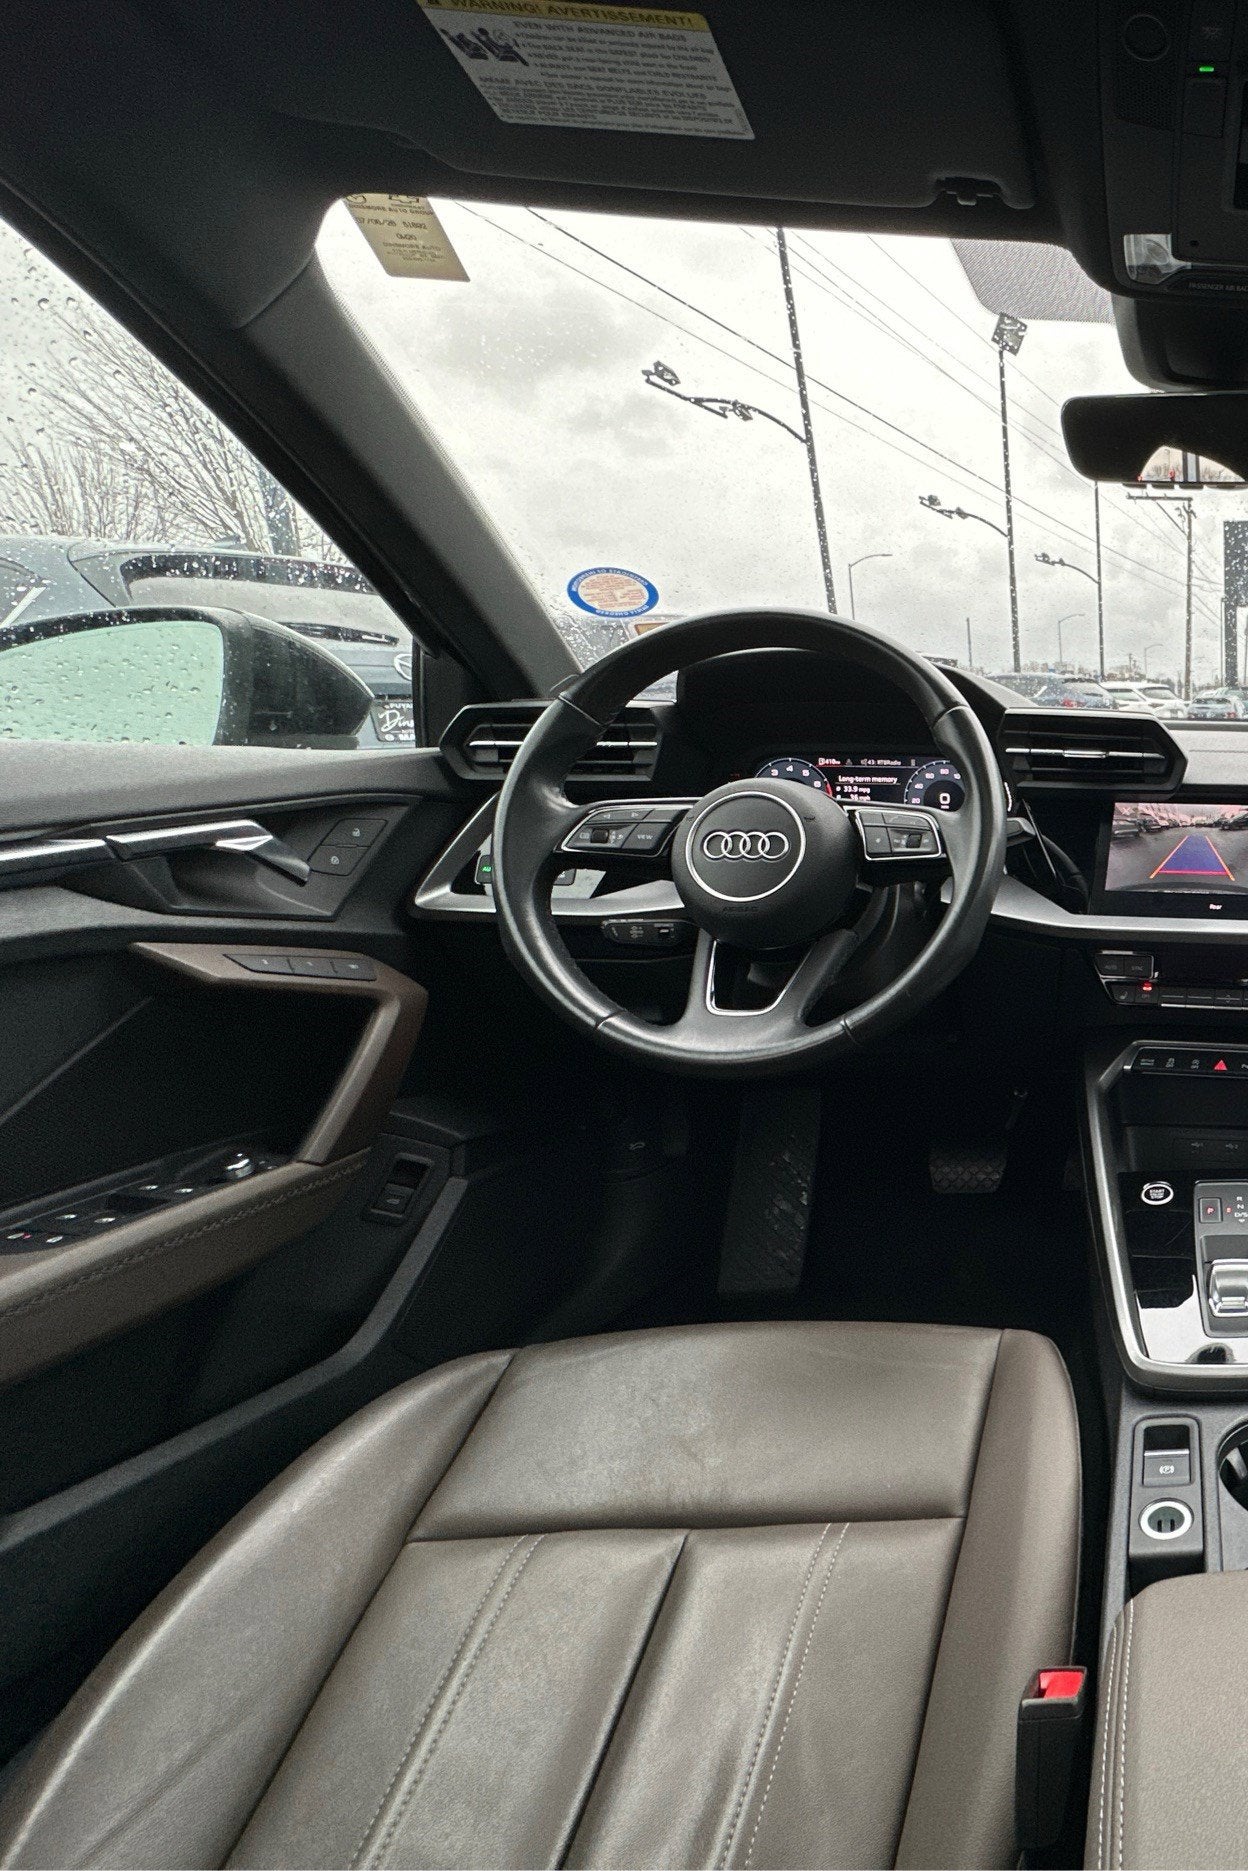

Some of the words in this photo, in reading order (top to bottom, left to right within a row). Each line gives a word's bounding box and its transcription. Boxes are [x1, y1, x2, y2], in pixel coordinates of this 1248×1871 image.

[547, 6, 693, 26] AVERTISSEMENT!
[770, 768, 779, 777] 3
[785, 764, 793, 772] 4
[838, 775, 871, 783] Long-term
[871, 776, 898, 784] memory
[843, 785, 858, 793] 33.9
[939, 792, 951, 805] 0
